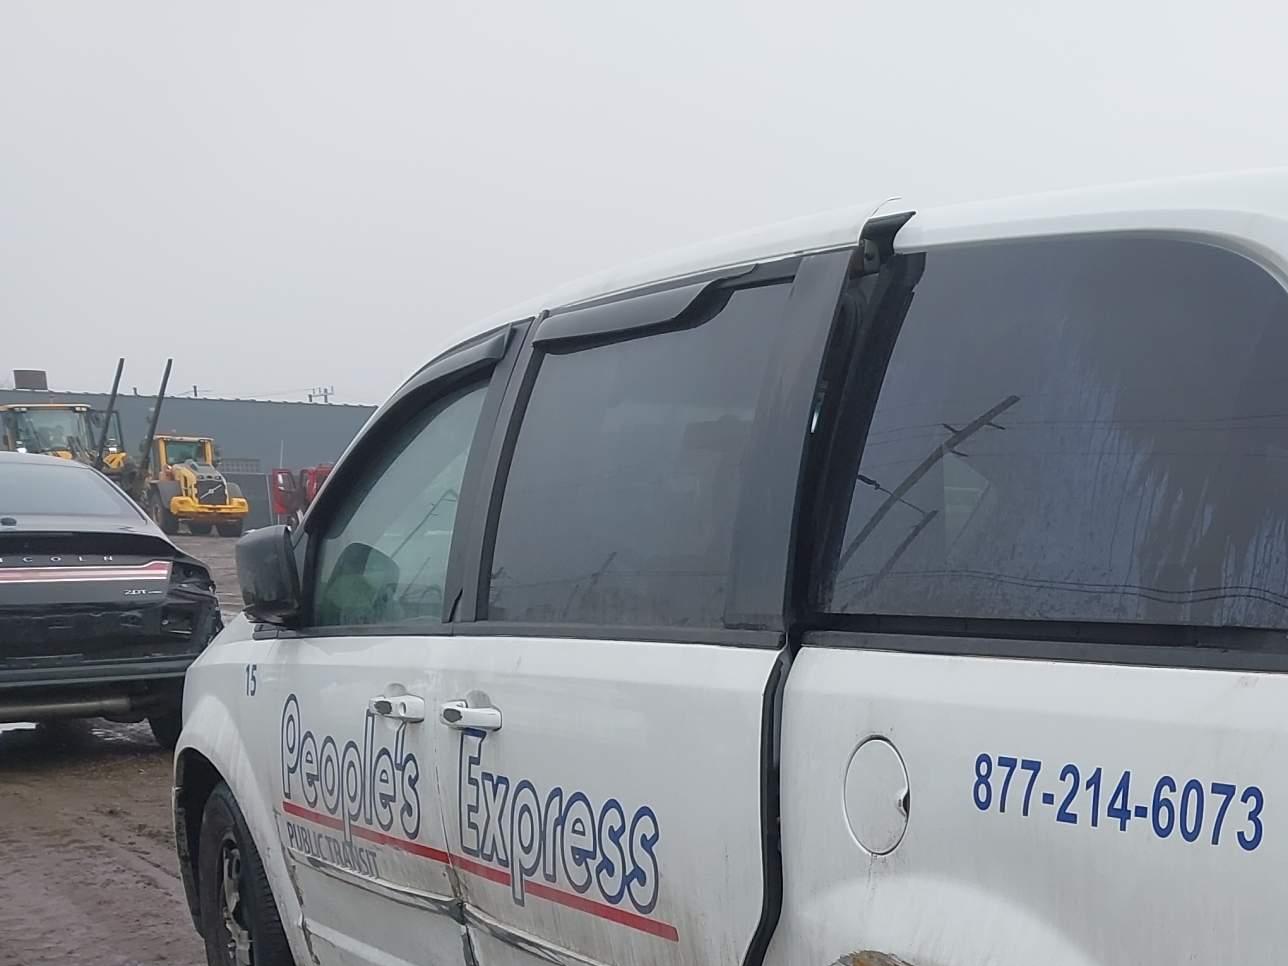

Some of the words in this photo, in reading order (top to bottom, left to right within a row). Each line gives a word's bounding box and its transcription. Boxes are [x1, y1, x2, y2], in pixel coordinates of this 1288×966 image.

[245, 664, 257, 696] 15
[281, 693, 420, 845] People's
[459, 728, 659, 914] Express
[973, 753, 1264, 851] 877-214-6073
[287, 822, 325, 859] PUBLIC
[324, 836, 380, 879] TRANSIT
